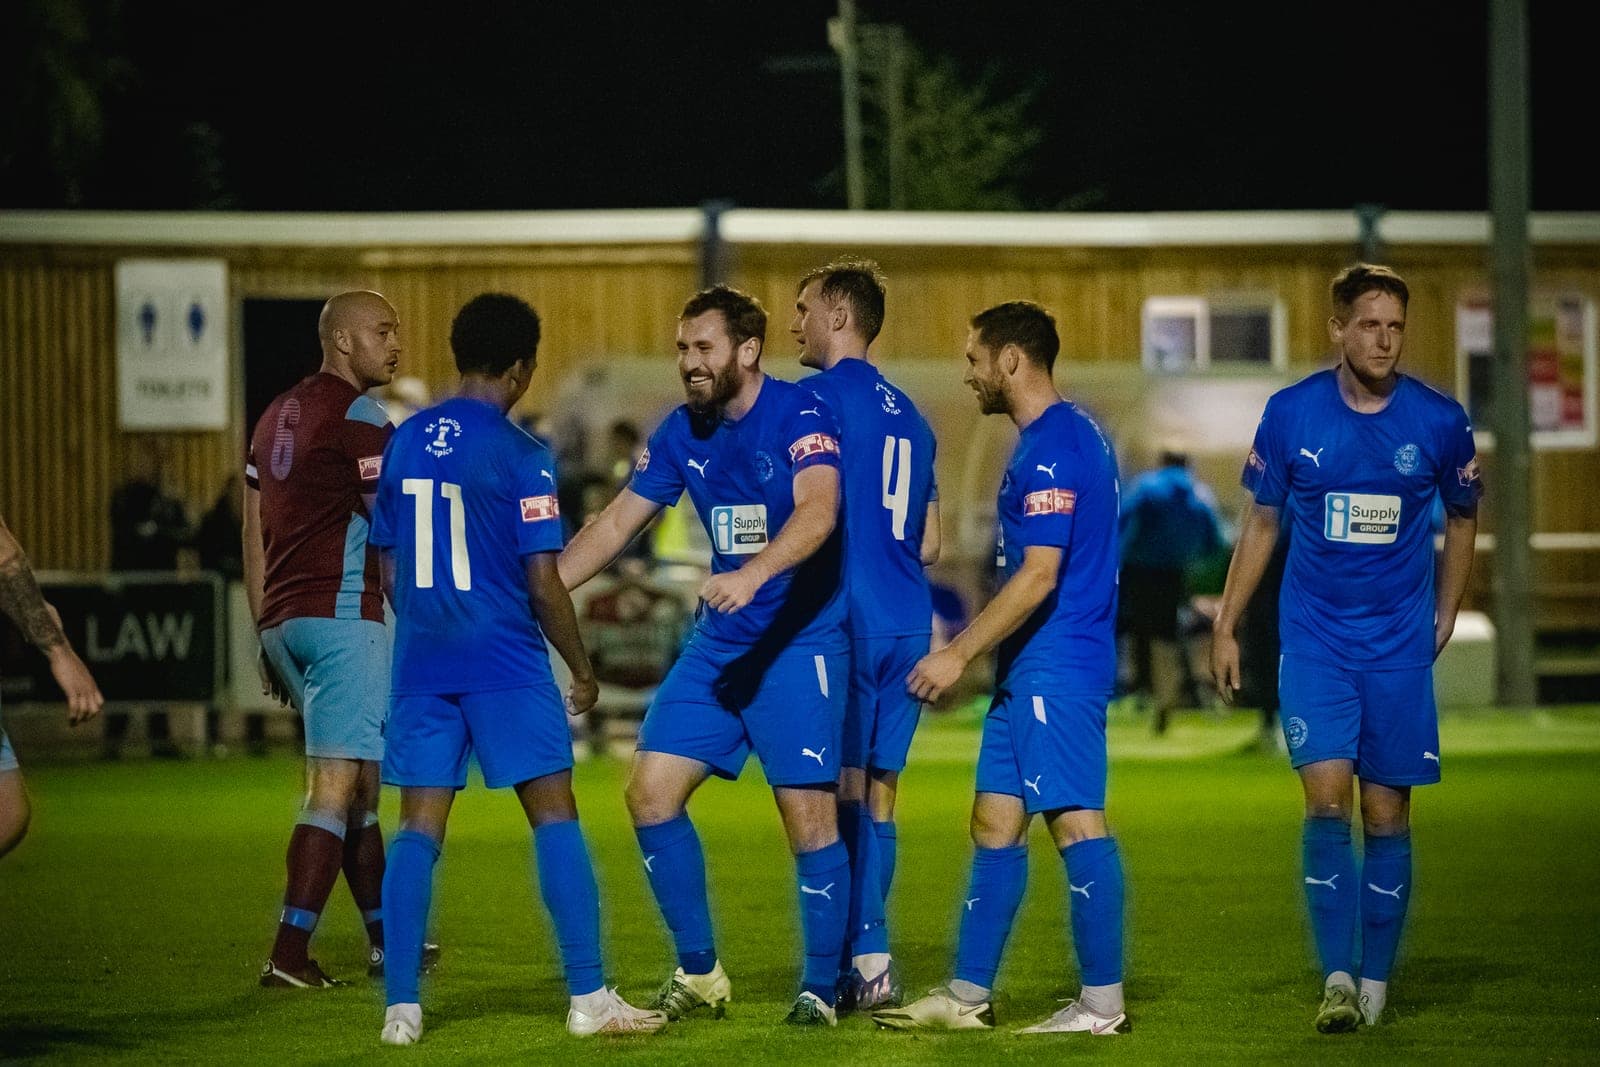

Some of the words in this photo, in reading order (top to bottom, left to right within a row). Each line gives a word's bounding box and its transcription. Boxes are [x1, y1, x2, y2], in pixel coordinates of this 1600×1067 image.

[271, 399, 300, 480] 6
[883, 435, 911, 540] 4
[1351, 505, 1399, 521] Supply
[402, 479, 471, 591] 11
[734, 516, 766, 531] Supply
[86, 612, 194, 661] LAW
